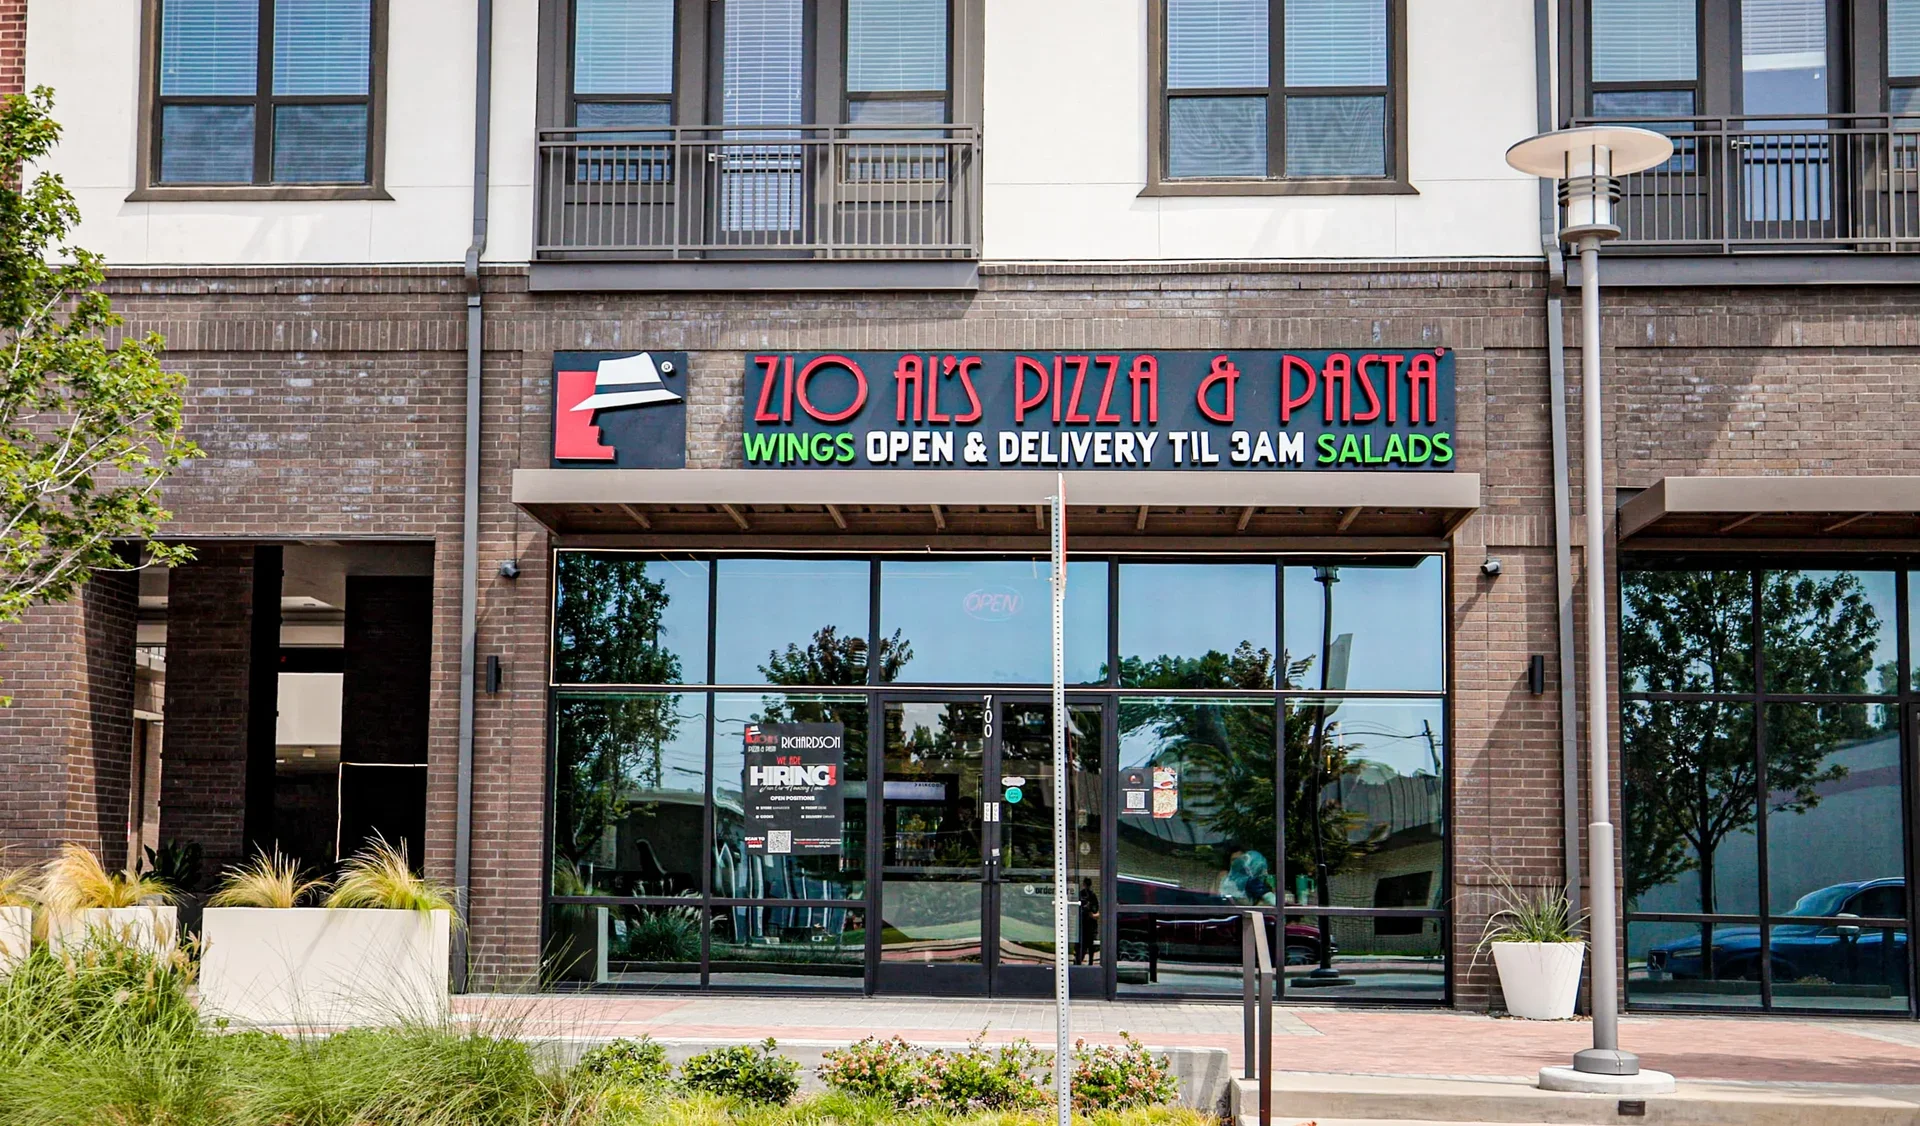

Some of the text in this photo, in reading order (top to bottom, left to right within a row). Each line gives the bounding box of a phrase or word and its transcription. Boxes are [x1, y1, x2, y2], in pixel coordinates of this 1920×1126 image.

[754, 354, 1437, 422] ZIO AL'S PIZZA & PASTA
[743, 431, 1454, 463] WINGS OPEN & DELIVERY TIL 3AM SALADS
[966, 593, 1018, 612] OPEN
[982, 694, 993, 738] 700
[781, 736, 840, 749] RICHARDSON
[750, 765, 837, 786] HIRING!
